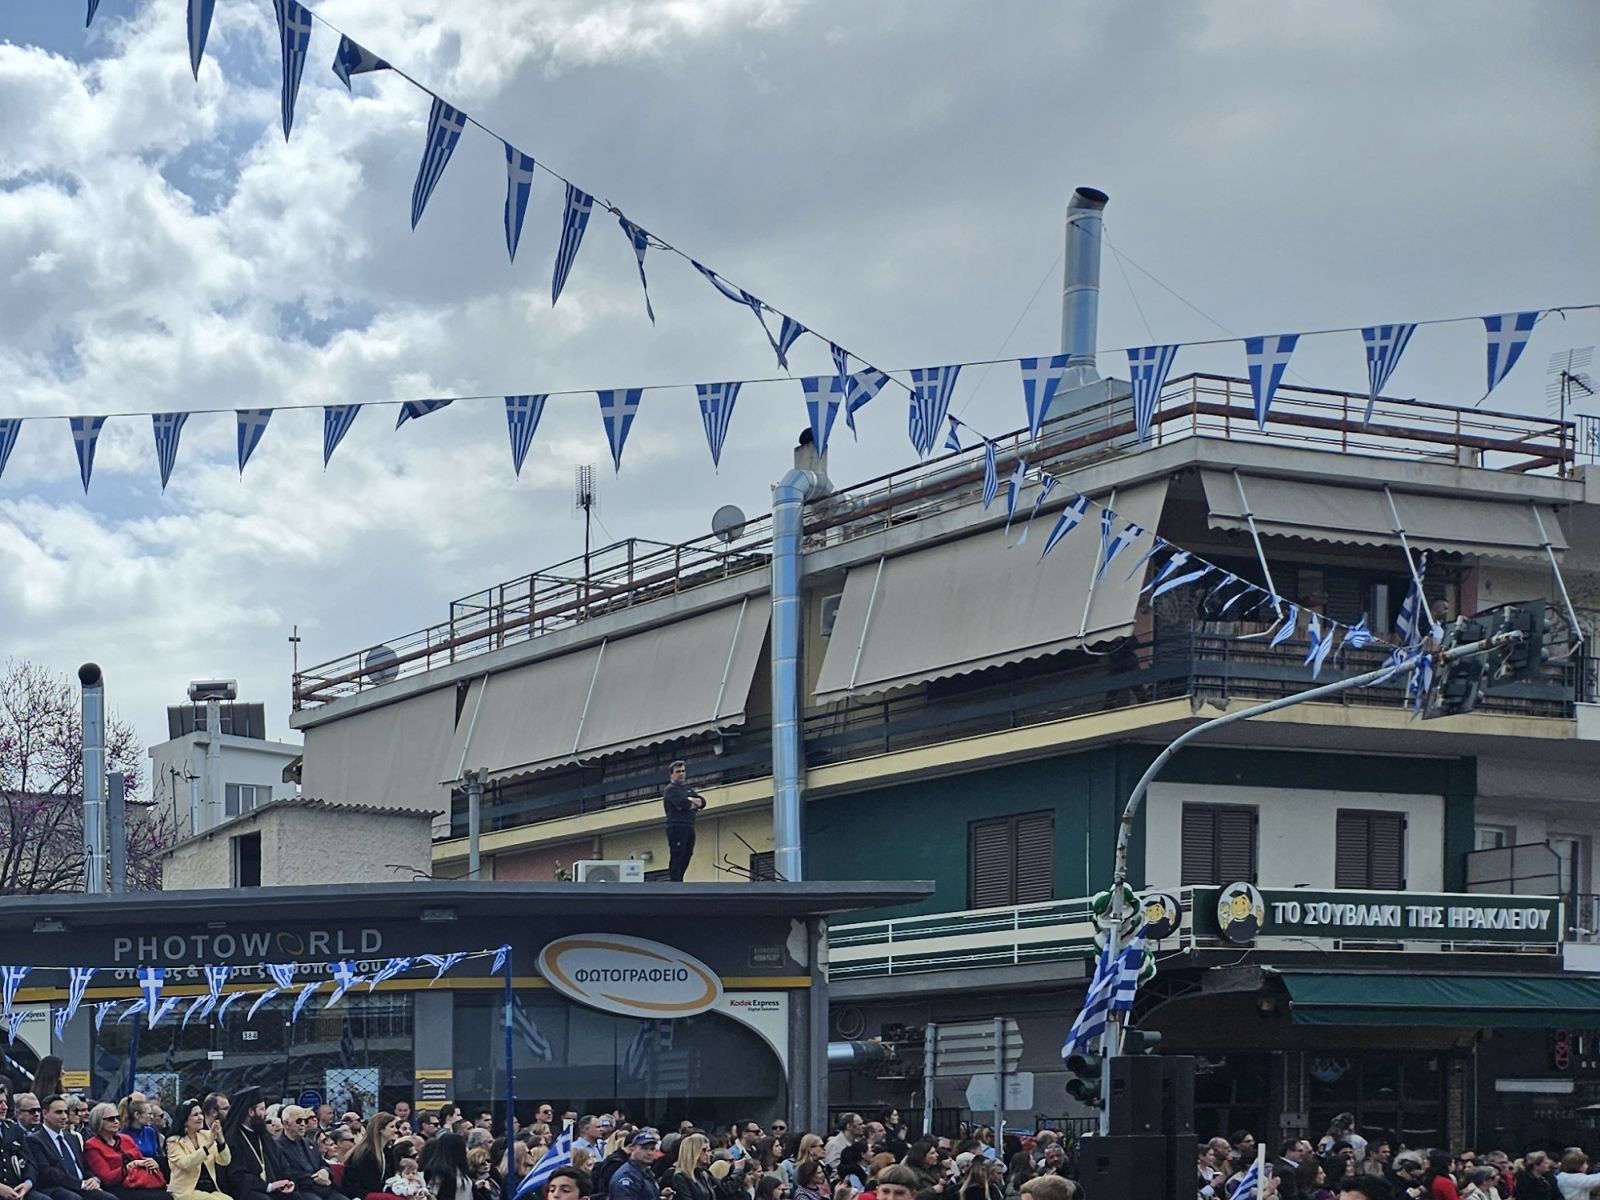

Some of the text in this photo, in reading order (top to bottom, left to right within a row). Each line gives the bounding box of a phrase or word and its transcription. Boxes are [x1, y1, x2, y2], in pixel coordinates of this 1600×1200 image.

[1272, 901, 1550, 930] ΤΟ ΣΟΥΒΛΑΚΙ ΤΗΣ ΗΡΑΚΛΕΙΟΥ
[575, 968, 689, 984] ΦΩΤΟΓΡΑΦΕΙΟ
